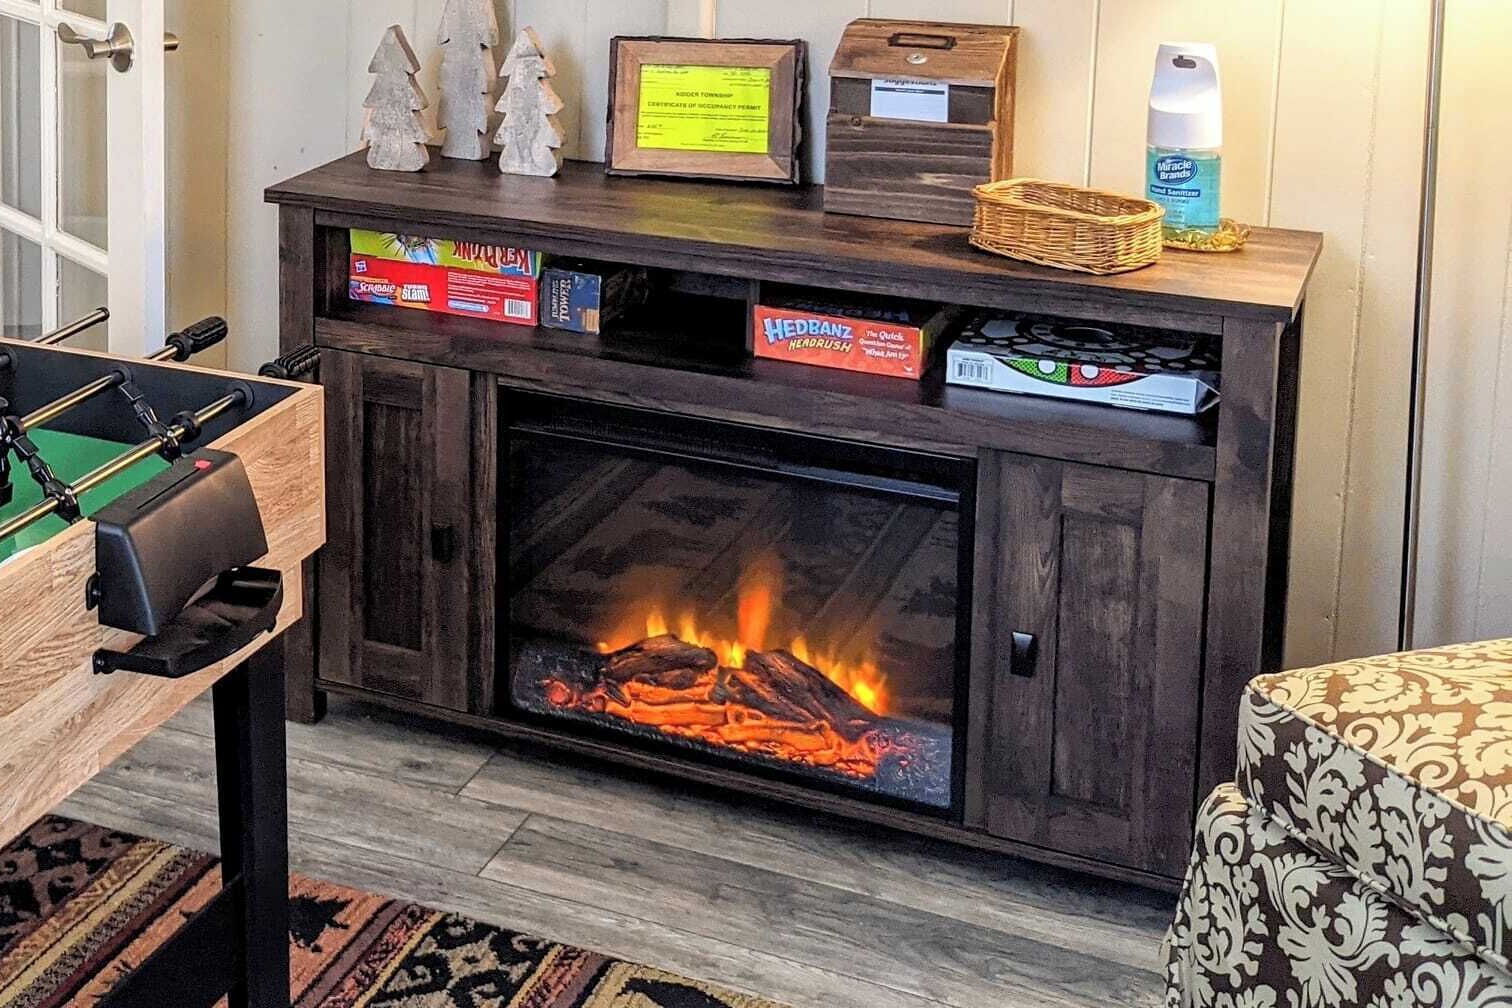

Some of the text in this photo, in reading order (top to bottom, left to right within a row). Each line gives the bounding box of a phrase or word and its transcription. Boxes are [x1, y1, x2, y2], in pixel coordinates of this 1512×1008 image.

[647, 101, 687, 109] CERTIFICATE
[1157, 160, 1193, 172] Miracle
[1159, 170, 1191, 180] Brands
[1168, 188, 1199, 197] Sanitizer
[559, 279, 572, 322] TOWER
[762, 317, 854, 344] HEDBANZ
[865, 329, 905, 342] The Quick
[788, 337, 852, 353] HEADRUSH
